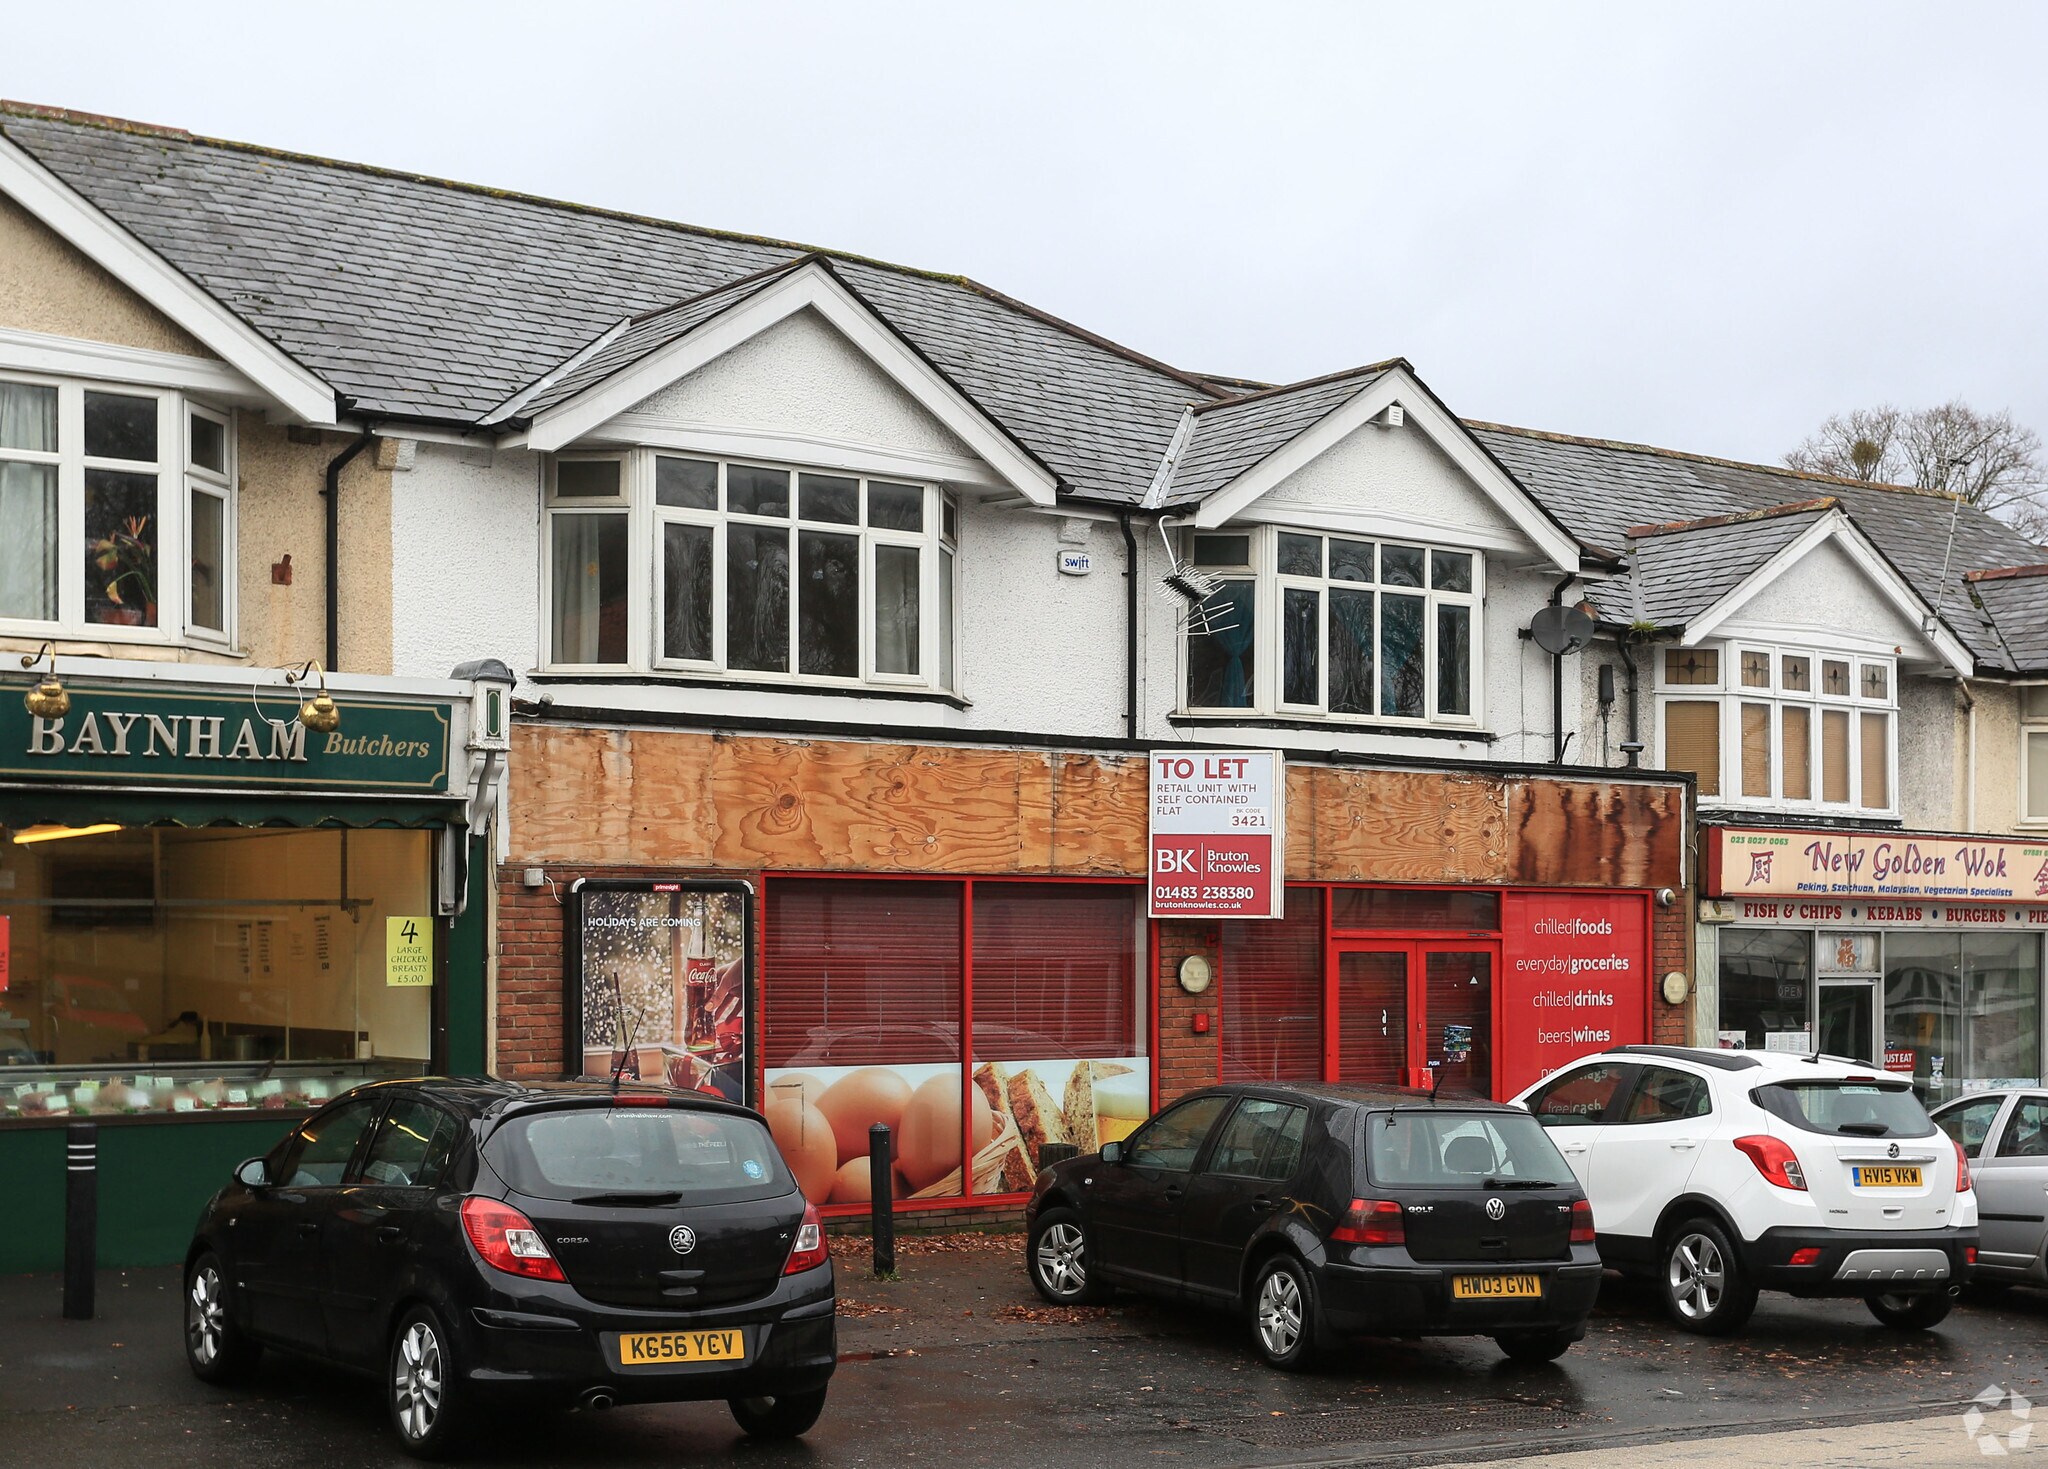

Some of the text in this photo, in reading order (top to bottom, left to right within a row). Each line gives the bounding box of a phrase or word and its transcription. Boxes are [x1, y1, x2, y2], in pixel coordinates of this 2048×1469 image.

[1065, 555, 1089, 570] swift
[26, 711, 308, 762] BAYNHAM
[322, 732, 430, 759] Butchers
[1157, 758, 1249, 779] TO LET
[1157, 784, 1257, 793] RETAIL UNIT WITH
[1157, 795, 1248, 804] SELF CONTAINED
[1157, 806, 1182, 816] FLAT
[1231, 815, 1266, 827] 3421
[1156, 849, 1198, 873] BK
[1207, 850, 1249, 862] Bruton
[1804, 841, 2007, 881] New Golden Wok
[1207, 861, 1261, 873] Knowles
[1155, 886, 1254, 899] 01483 238380
[1797, 882, 1829, 893] Peking,
[1878, 884, 1922, 895] Malaysian,
[1924, 886, 1968, 896] Vegetarian
[1970, 887, 2013, 897] Specialists
[1155, 901, 1242, 909] brutonknowles.co.uk
[1744, 902, 1778, 918] FISH
[1783, 903, 1795, 919] &
[1800, 904, 1842, 920] CHIPS
[1866, 906, 1923, 921] KEBABS
[1946, 907, 2006, 923] BURGERS
[588, 917, 701, 927] HOLIDAYS ARE COMING
[401, 920, 419, 944] 4
[397, 946, 423, 954] LARGE
[391, 955, 428, 963] CHICKEN
[392, 964, 427, 973] BREASTS
[398, 974, 424, 983] £5.00
[1900, 1053, 1912, 1063] EAT
[1863, 1168, 1918, 1184] HV15 VKW
[1461, 1276, 1535, 1294] HW03 GVN
[631, 1333, 733, 1359] KG56 YCV
